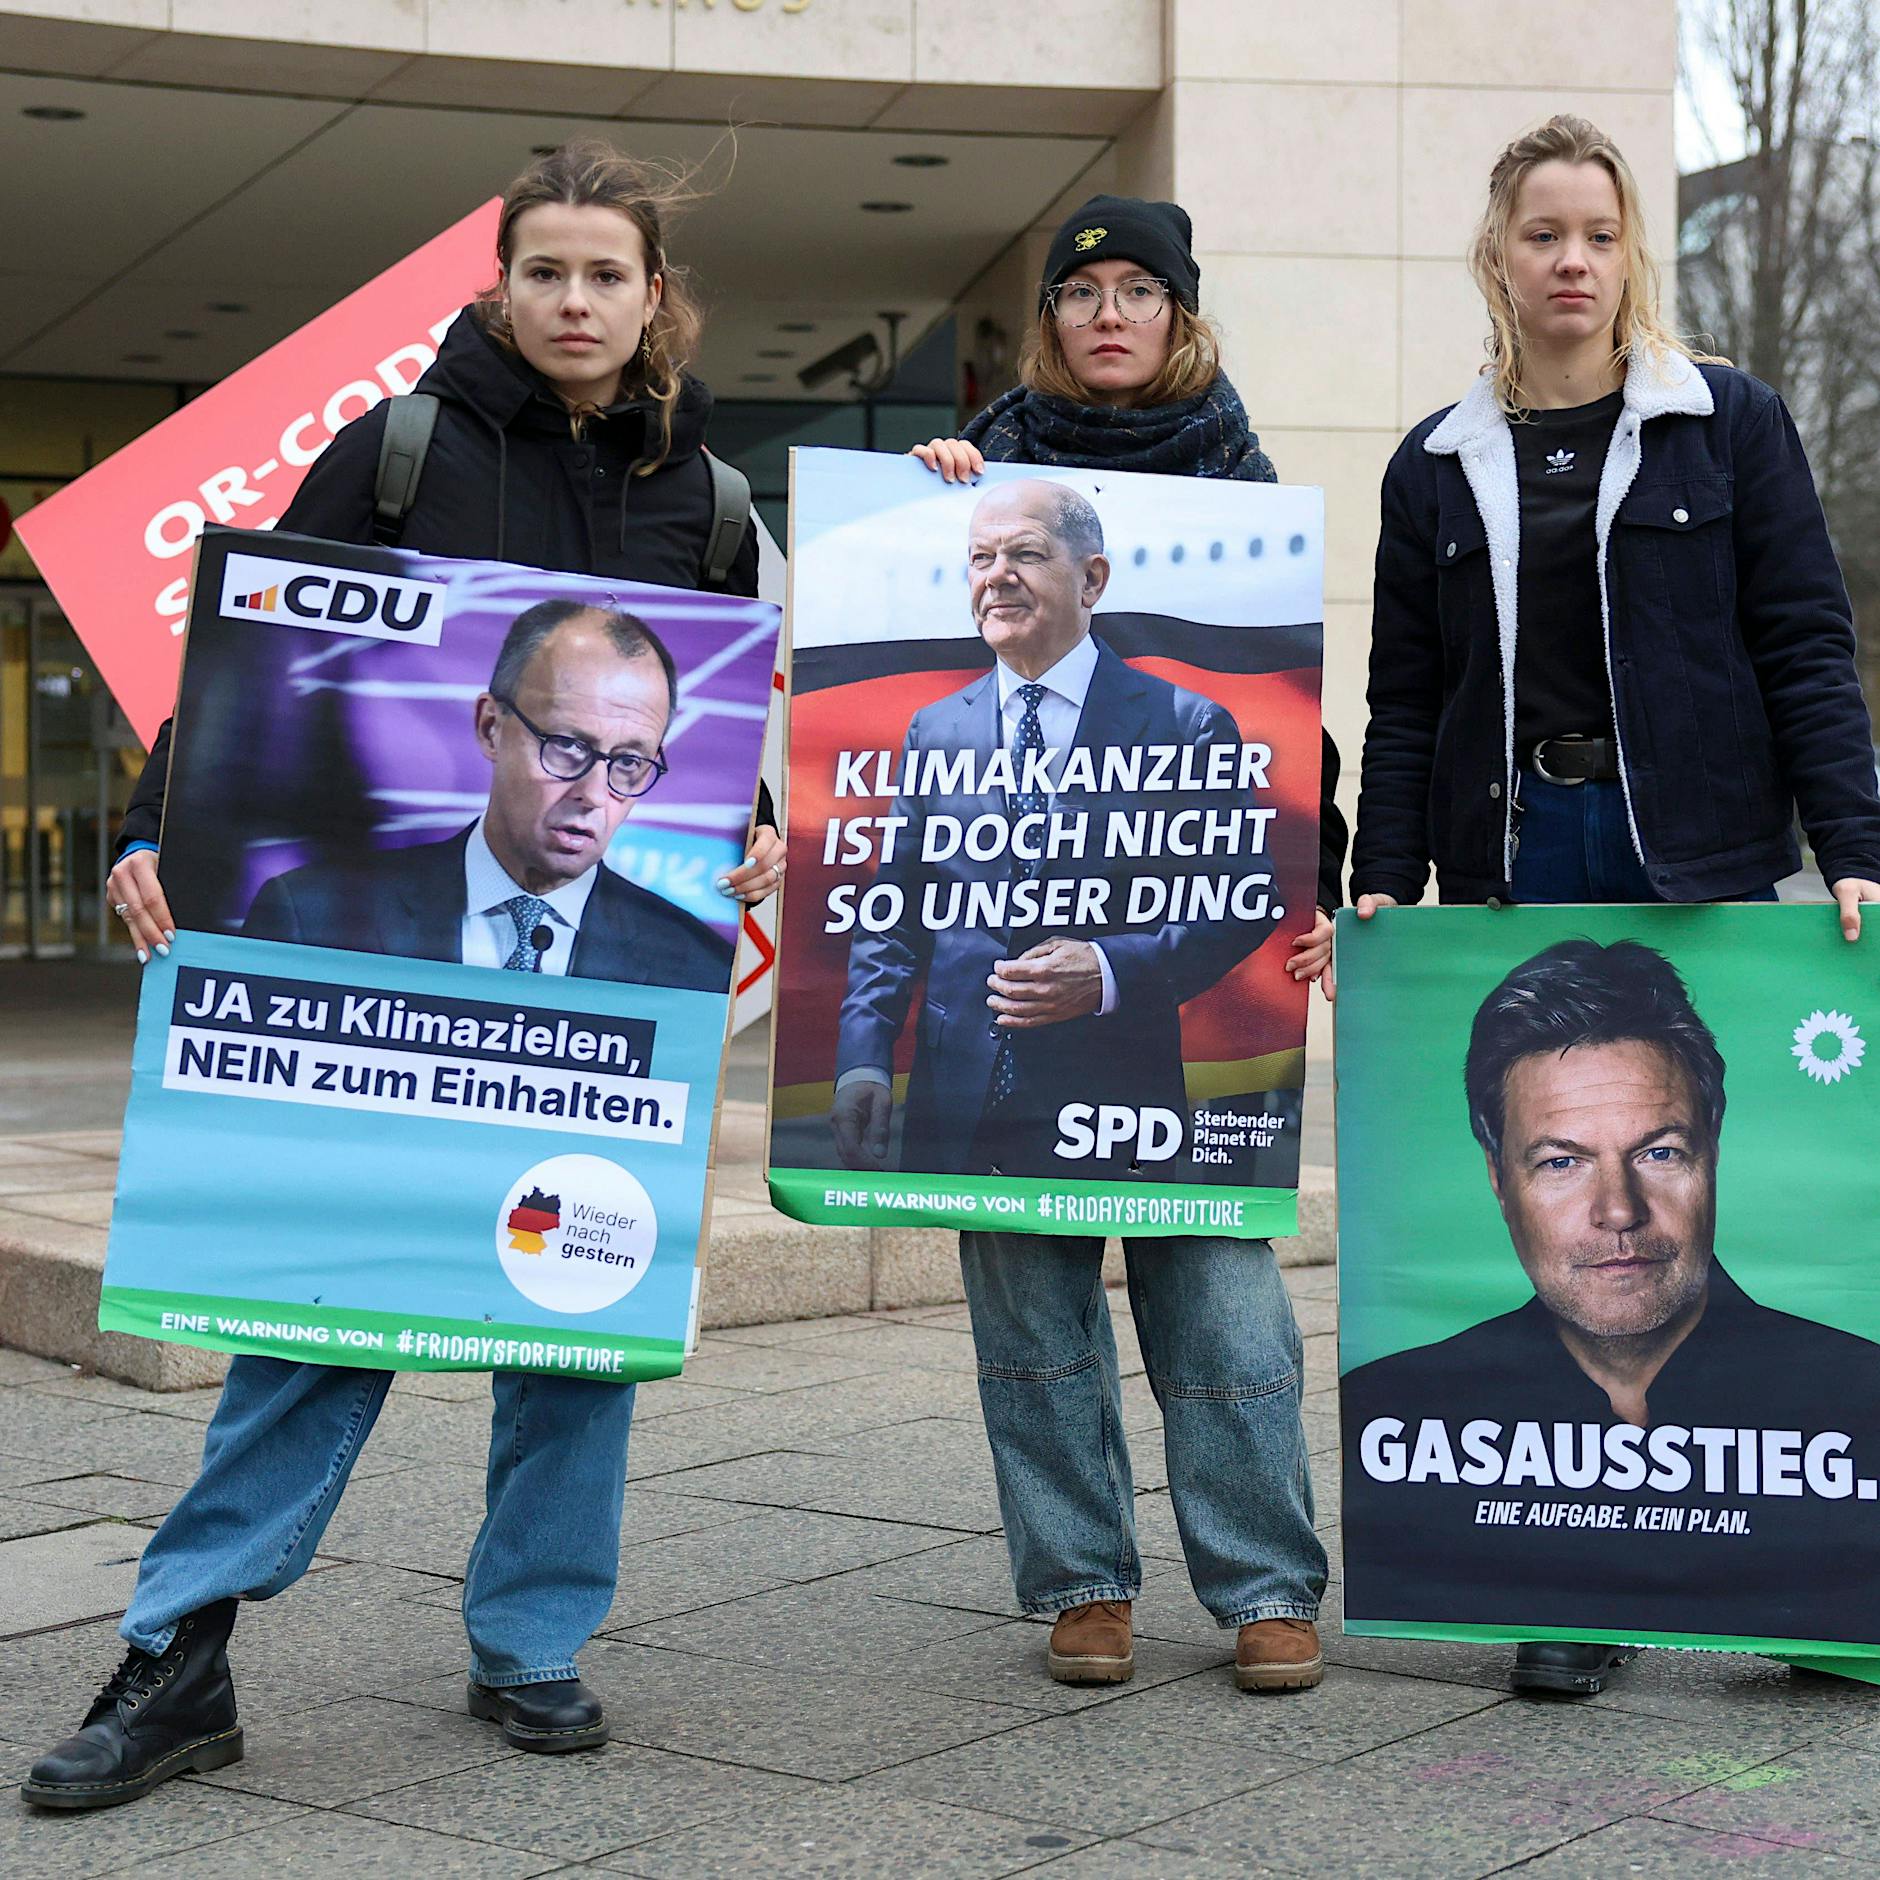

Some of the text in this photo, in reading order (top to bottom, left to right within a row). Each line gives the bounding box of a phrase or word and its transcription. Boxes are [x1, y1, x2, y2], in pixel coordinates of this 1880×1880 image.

[284, 575, 432, 631] CDU
[834, 743, 1273, 798] KLIMAKANZLER
[822, 808, 1277, 866] IST DOCH NICHT
[824, 873, 1286, 935] SO UNSER DING.
[184, 979, 641, 1075] JA zu Klimazielen,
[178, 1038, 673, 1129] NEIN zum Einhalten.
[1053, 1102, 1184, 1162] SPD
[1193, 1128, 1274, 1147] Planet für
[1194, 1110, 1285, 1129] Sterbender
[1192, 1147, 1233, 1164] Dich.
[566, 1223, 611, 1244] nach
[573, 1202, 637, 1230] Wieder
[824, 1190, 1244, 1226] EINE WARNUNG VON #FRIDAYSFORFUTURE
[561, 1242, 635, 1269] gestern
[161, 1312, 625, 1373] EINE WARNUNG VON #FRIDAYSFORFUTURE
[1360, 1417, 1878, 1500] GASAUSSTIEG.
[1474, 1501, 1751, 1535] EINE AUFGABE. KEIN PLAN.
